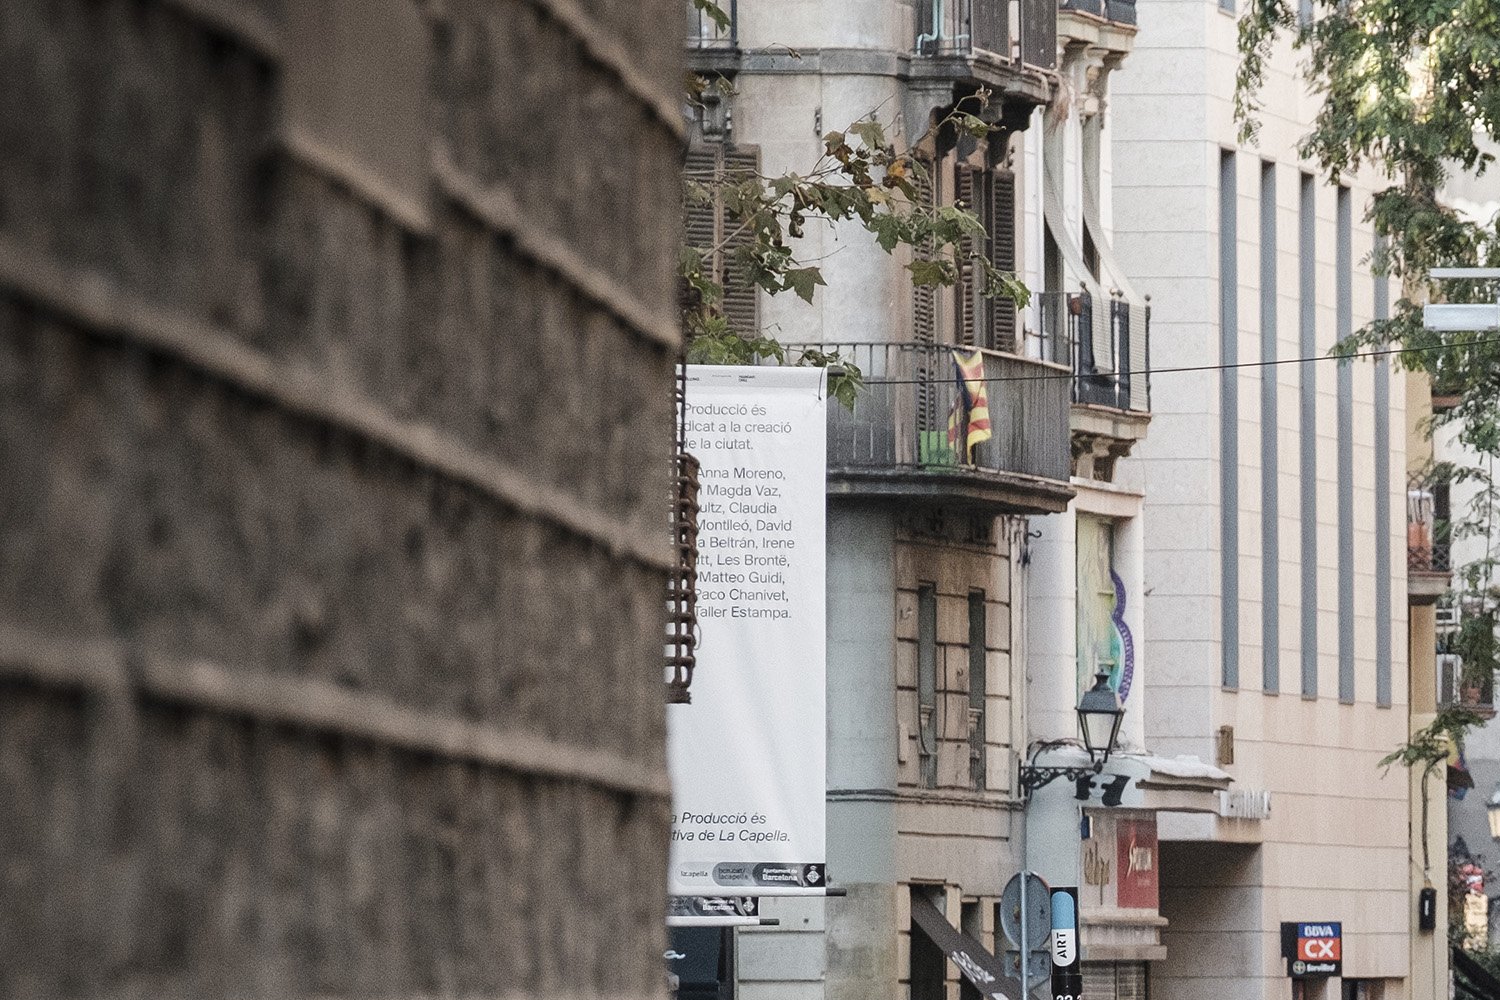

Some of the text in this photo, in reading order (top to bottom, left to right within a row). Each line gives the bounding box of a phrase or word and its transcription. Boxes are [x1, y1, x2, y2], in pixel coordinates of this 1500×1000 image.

[684, 403, 767, 416] Producció és
[676, 421, 792, 434] edicat a la creació
[700, 438, 711, 449] la
[715, 438, 754, 450] ciutat.
[697, 467, 786, 480] Anna Moreno,
[706, 484, 752, 499] Magda
[755, 485, 781, 497] Vaz,
[699, 502, 777, 514] ultz, Claudia
[756, 520, 792, 531] David
[709, 536, 758, 549] Beltrán,
[762, 537, 795, 548] Irene
[717, 554, 740, 566] Les
[744, 554, 790, 568] Brontë,
[699, 571, 785, 585] Matteo Guidi,
[694, 588, 789, 602] Paco Chanivet,
[694, 606, 792, 621] Taller Estampa.
[681, 811, 747, 824] Producció
[750, 812, 767, 824] és
[671, 829, 791, 844] tiva de La Capella.
[1304, 925, 1334, 937] BBVA
[1056, 931, 1067, 959] ART
[1304, 939, 1335, 958] CX
